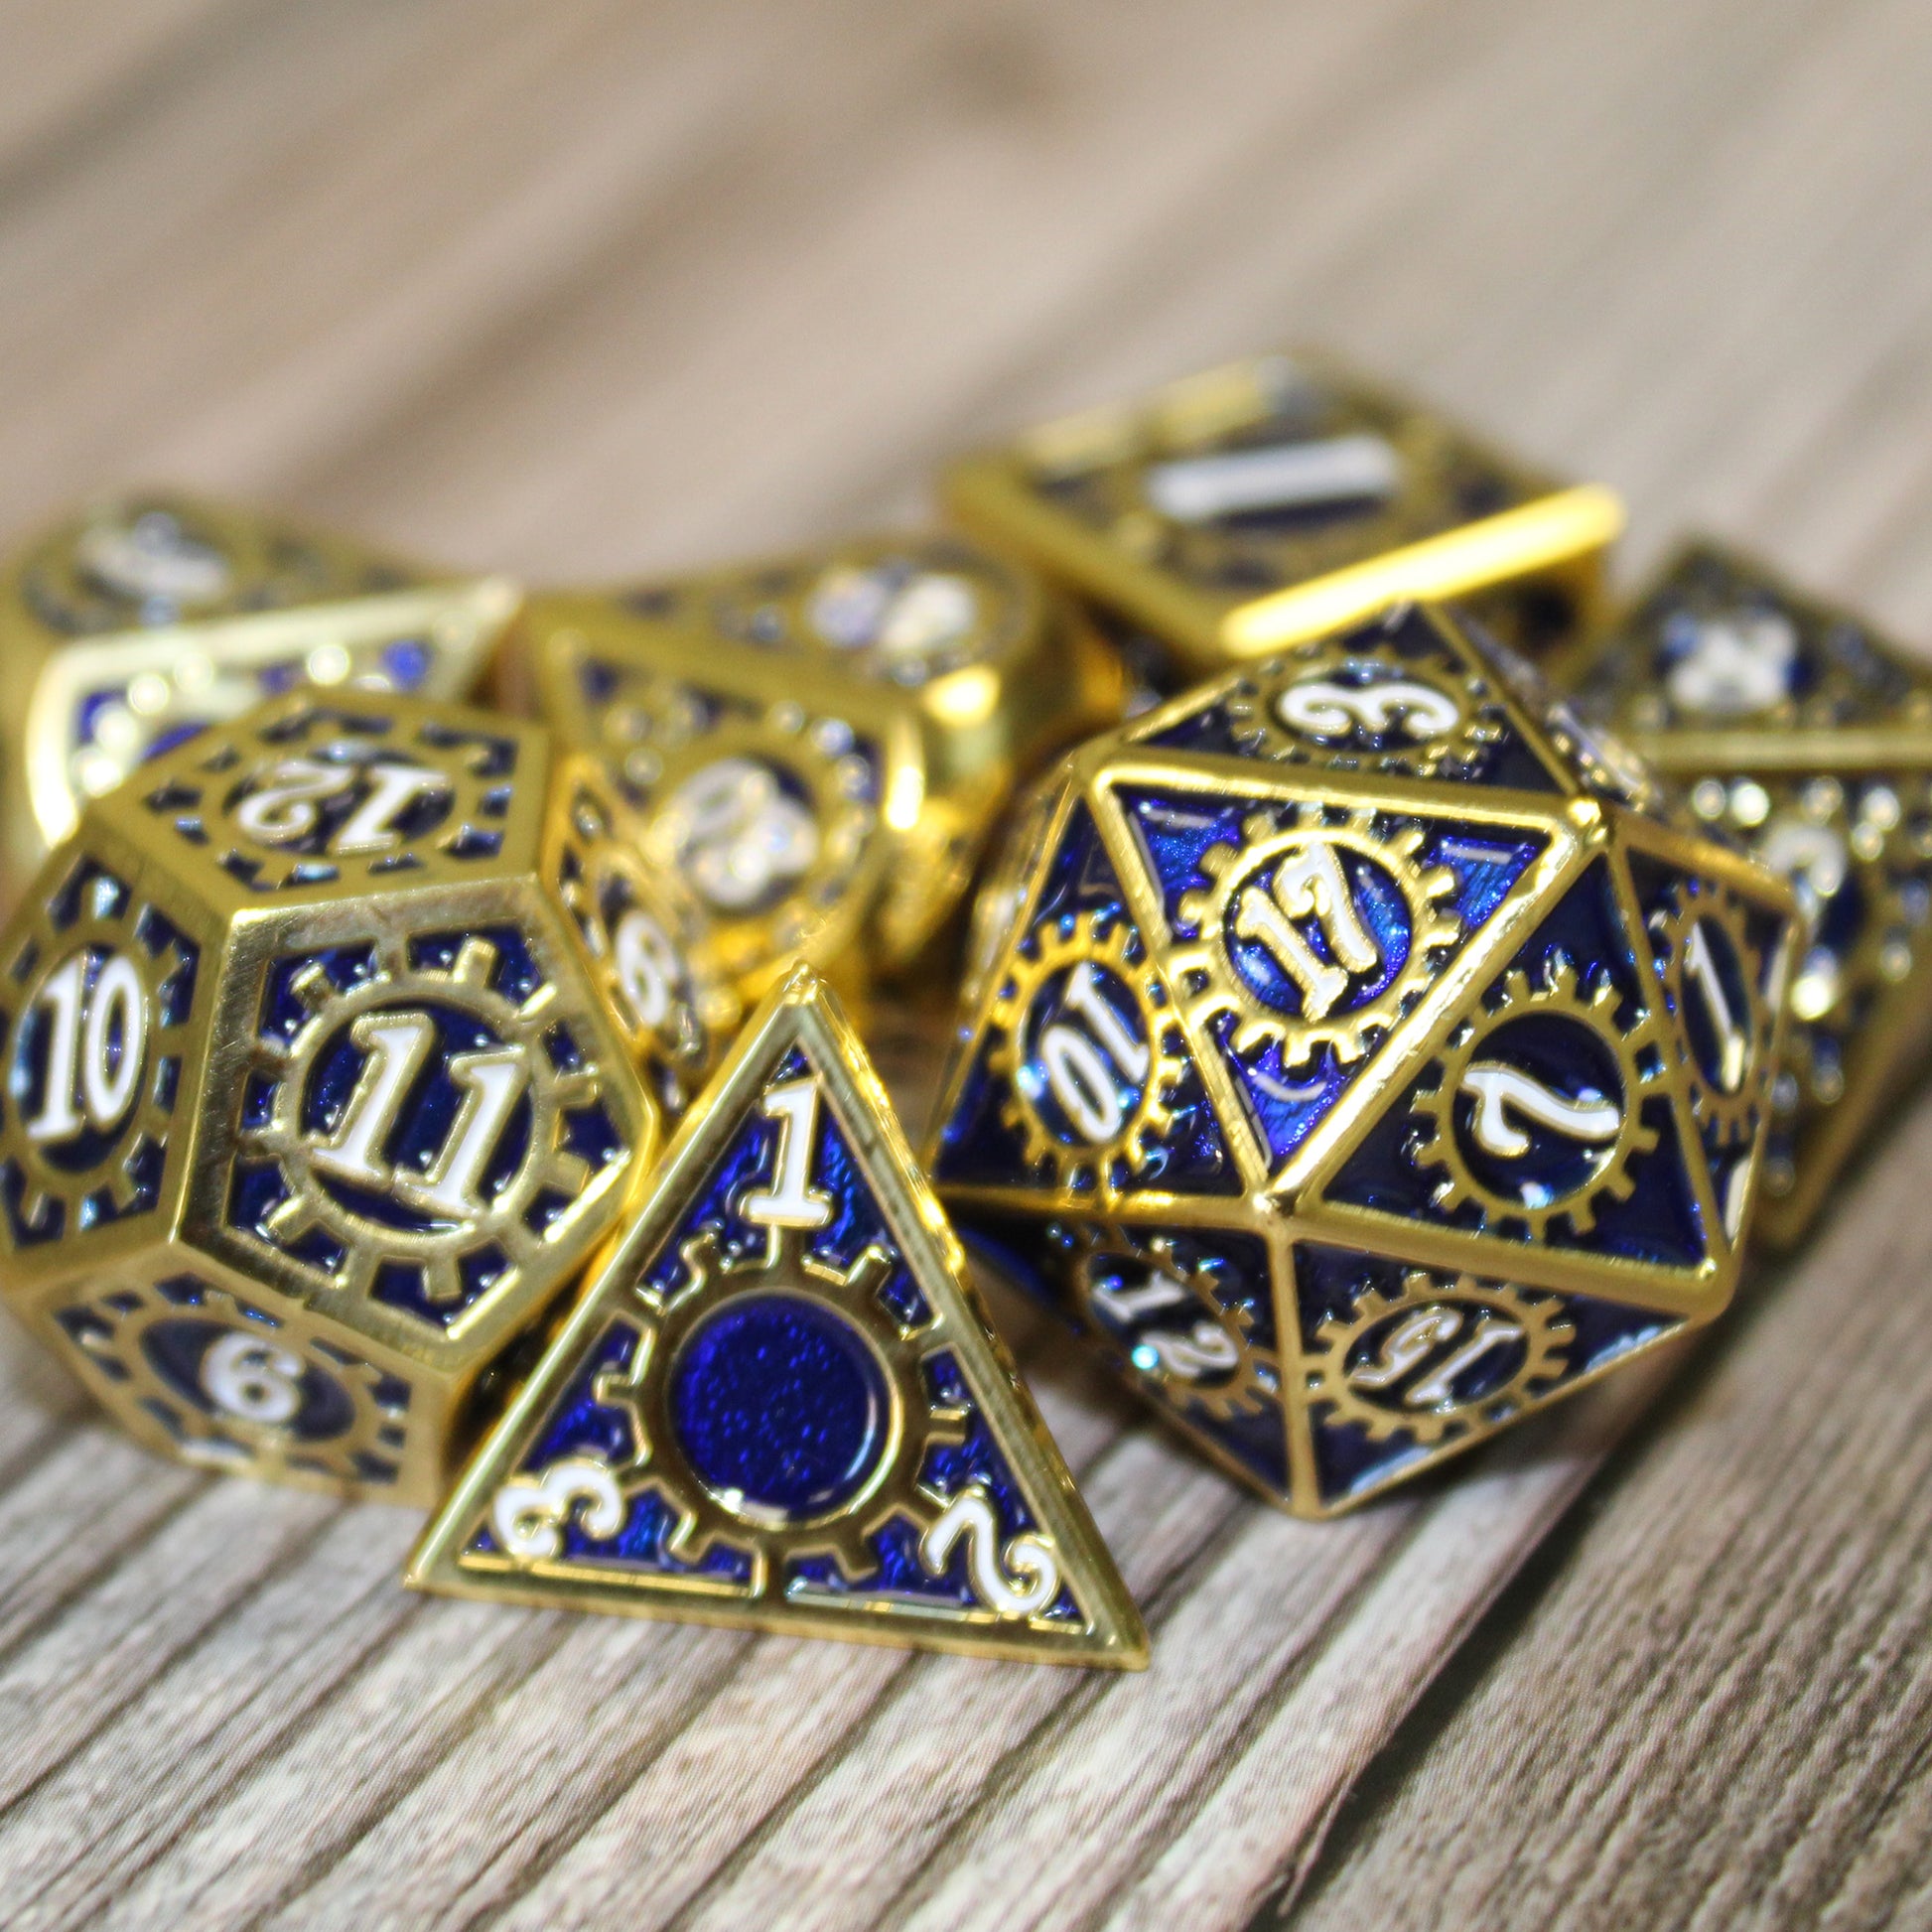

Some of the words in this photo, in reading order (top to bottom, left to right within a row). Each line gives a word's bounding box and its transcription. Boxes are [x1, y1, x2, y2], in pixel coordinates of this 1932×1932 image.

[1280, 681, 1460, 736] 3
[238, 760, 452, 856] 12
[1237, 843, 1378, 1022] 17
[26, 952, 149, 1143] 10
[1042, 958, 1152, 1142] 10
[309, 1018, 522, 1215] 11
[744, 1079, 832, 1227] 1
[1461, 1061, 1621, 1157] 7
[204, 1331, 303, 1421] 6
[1352, 1308, 1526, 1406] 15
[492, 1460, 625, 1560] 3
[923, 1491, 1060, 1614] 2
